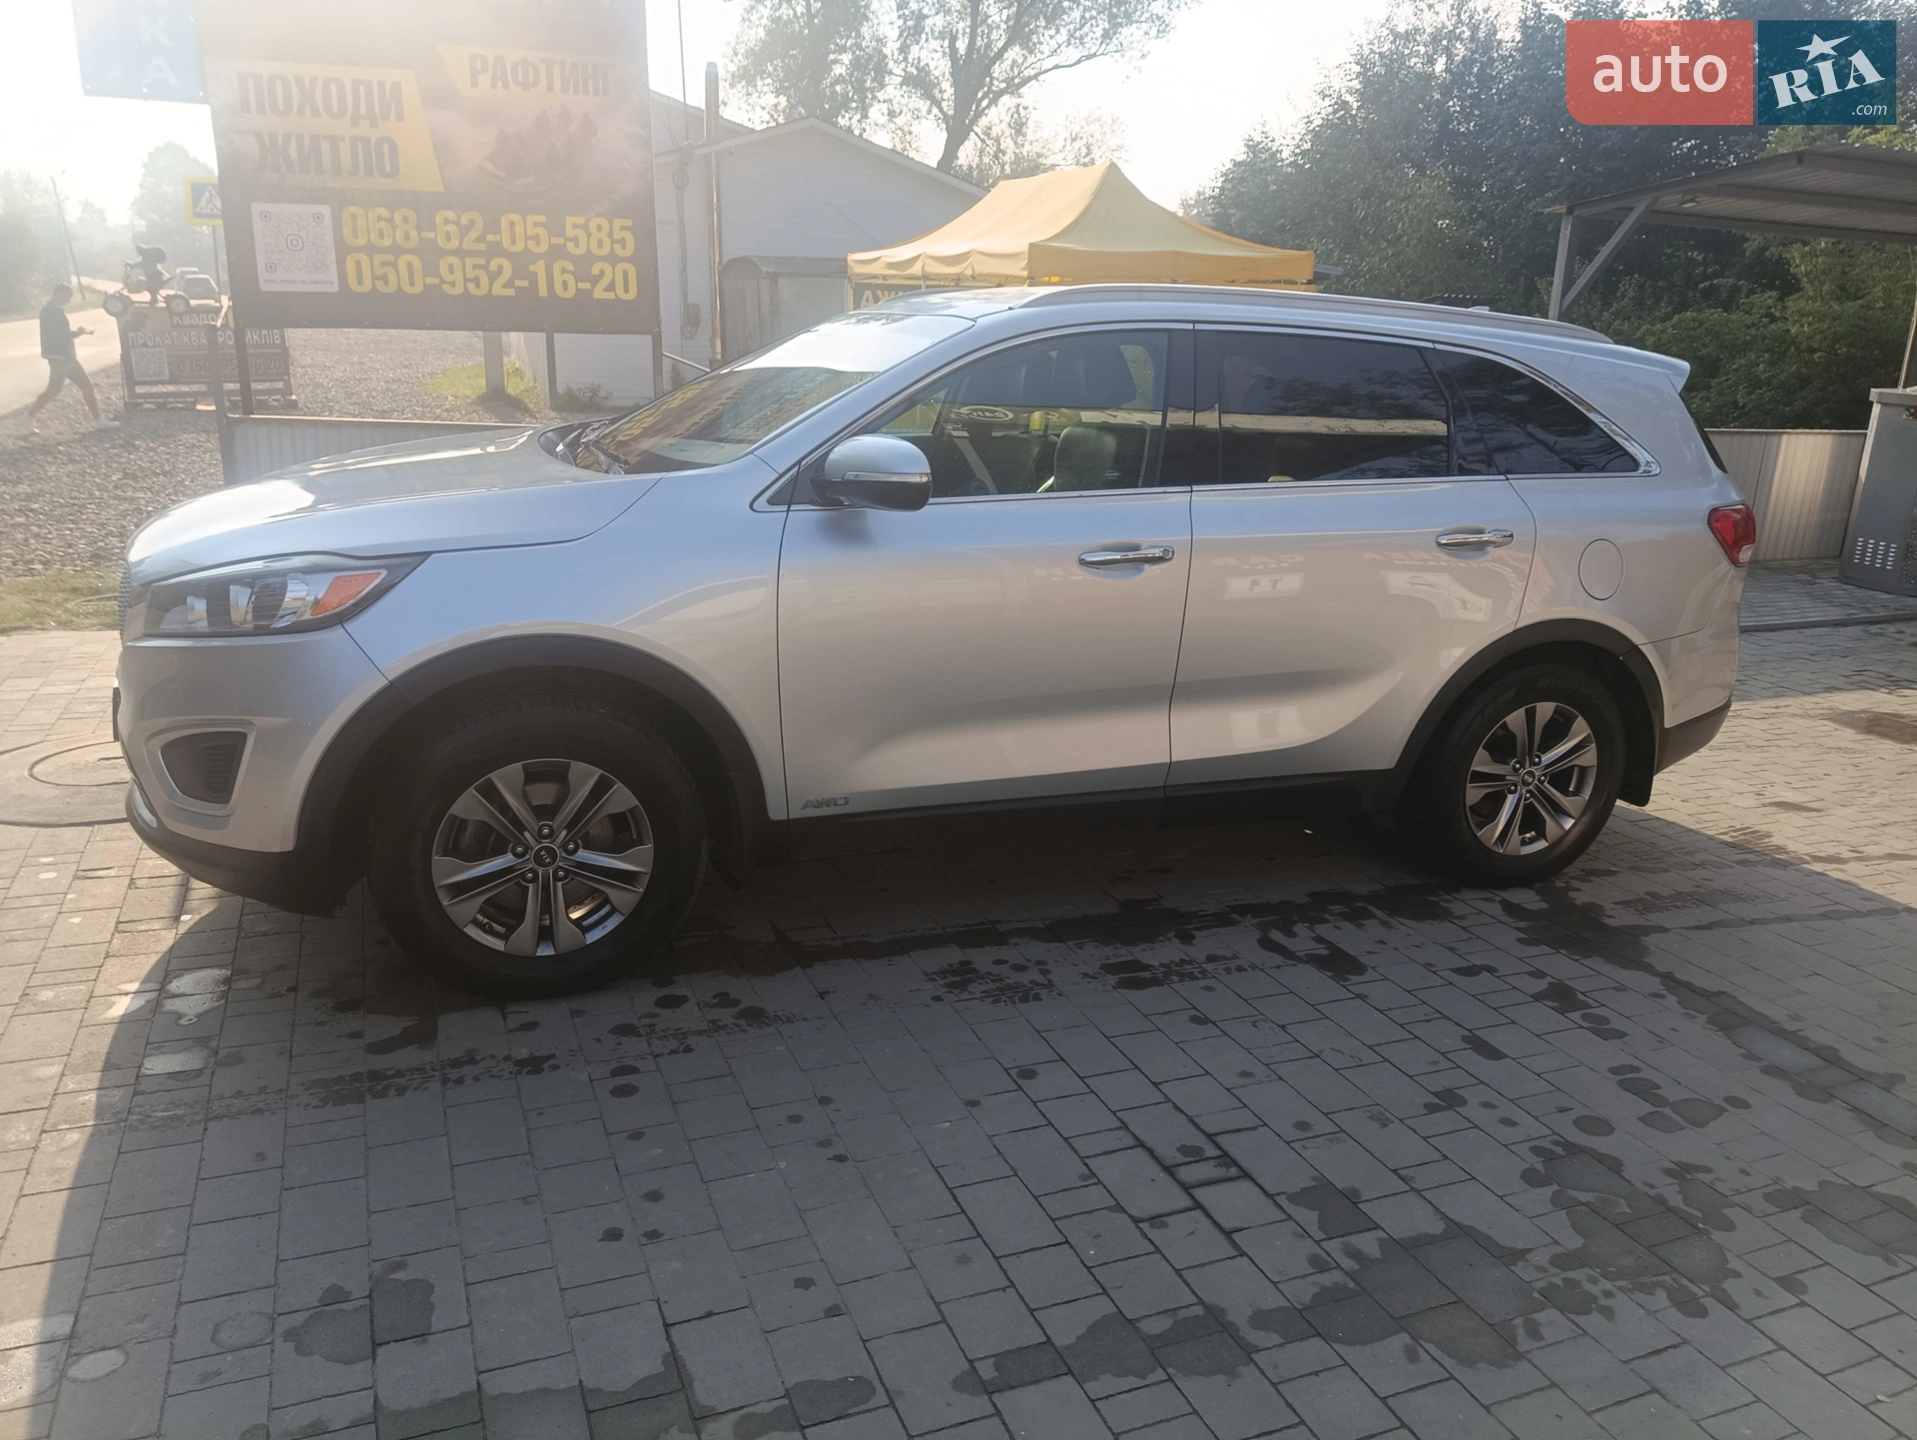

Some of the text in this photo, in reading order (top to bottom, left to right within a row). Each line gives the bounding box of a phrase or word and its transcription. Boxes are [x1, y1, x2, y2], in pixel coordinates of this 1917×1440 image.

[467, 52, 616, 97] РАФТИНГ
[237, 71, 404, 129] ПОХОДИ
[252, 130, 400, 179] ЖИТЛО
[341, 206, 635, 257] 068-62-05-585
[345, 253, 638, 300] 050-952-16-20
[128, 330, 281, 347] ПРОКАТ КВАРОИКЛІВ
[801, 797, 849, 810] AWD
